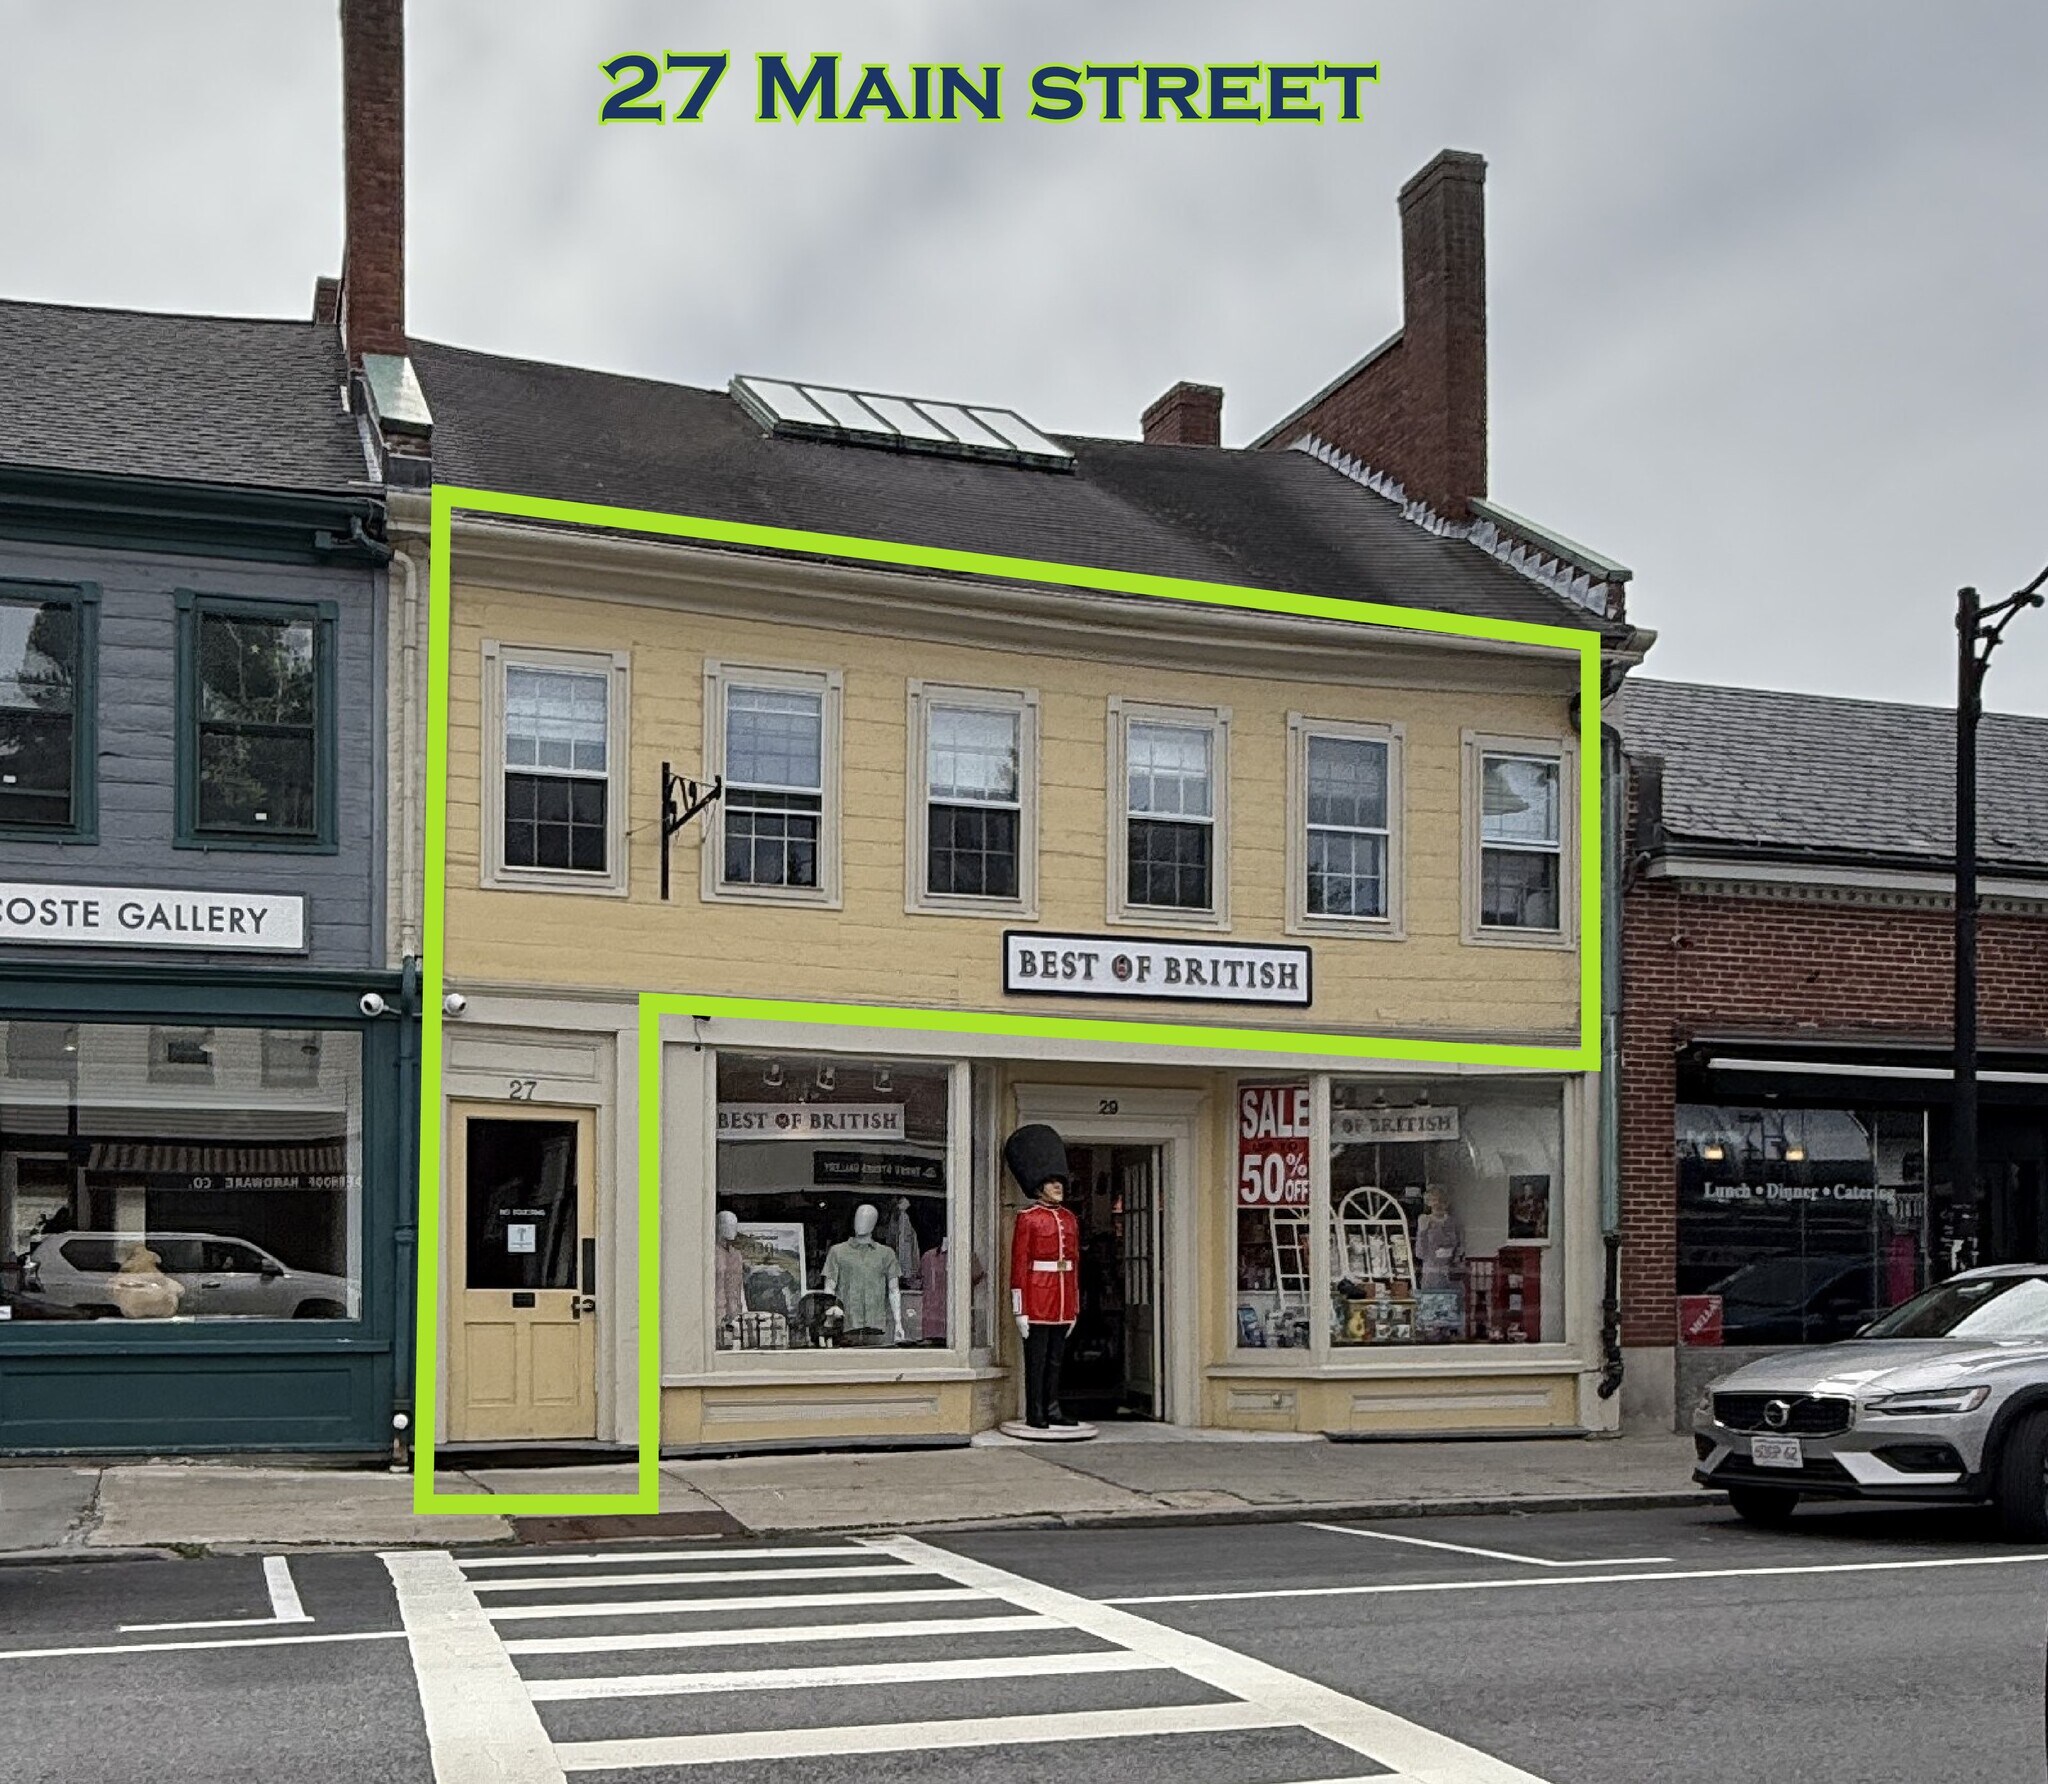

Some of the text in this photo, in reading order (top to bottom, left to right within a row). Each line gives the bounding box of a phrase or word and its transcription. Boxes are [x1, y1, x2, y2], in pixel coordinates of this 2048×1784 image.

[118, 902, 268, 934] GALLERY
[1019, 949, 1298, 989] BEST OF BRITISH
[509, 1079, 537, 1101] 27
[718, 1112, 898, 1129] BEST OF BRITISH
[1242, 1089, 1309, 1139] SALE
[1285, 1179, 1309, 1202] OFF
[1704, 1182, 1751, 1203] Lunch
